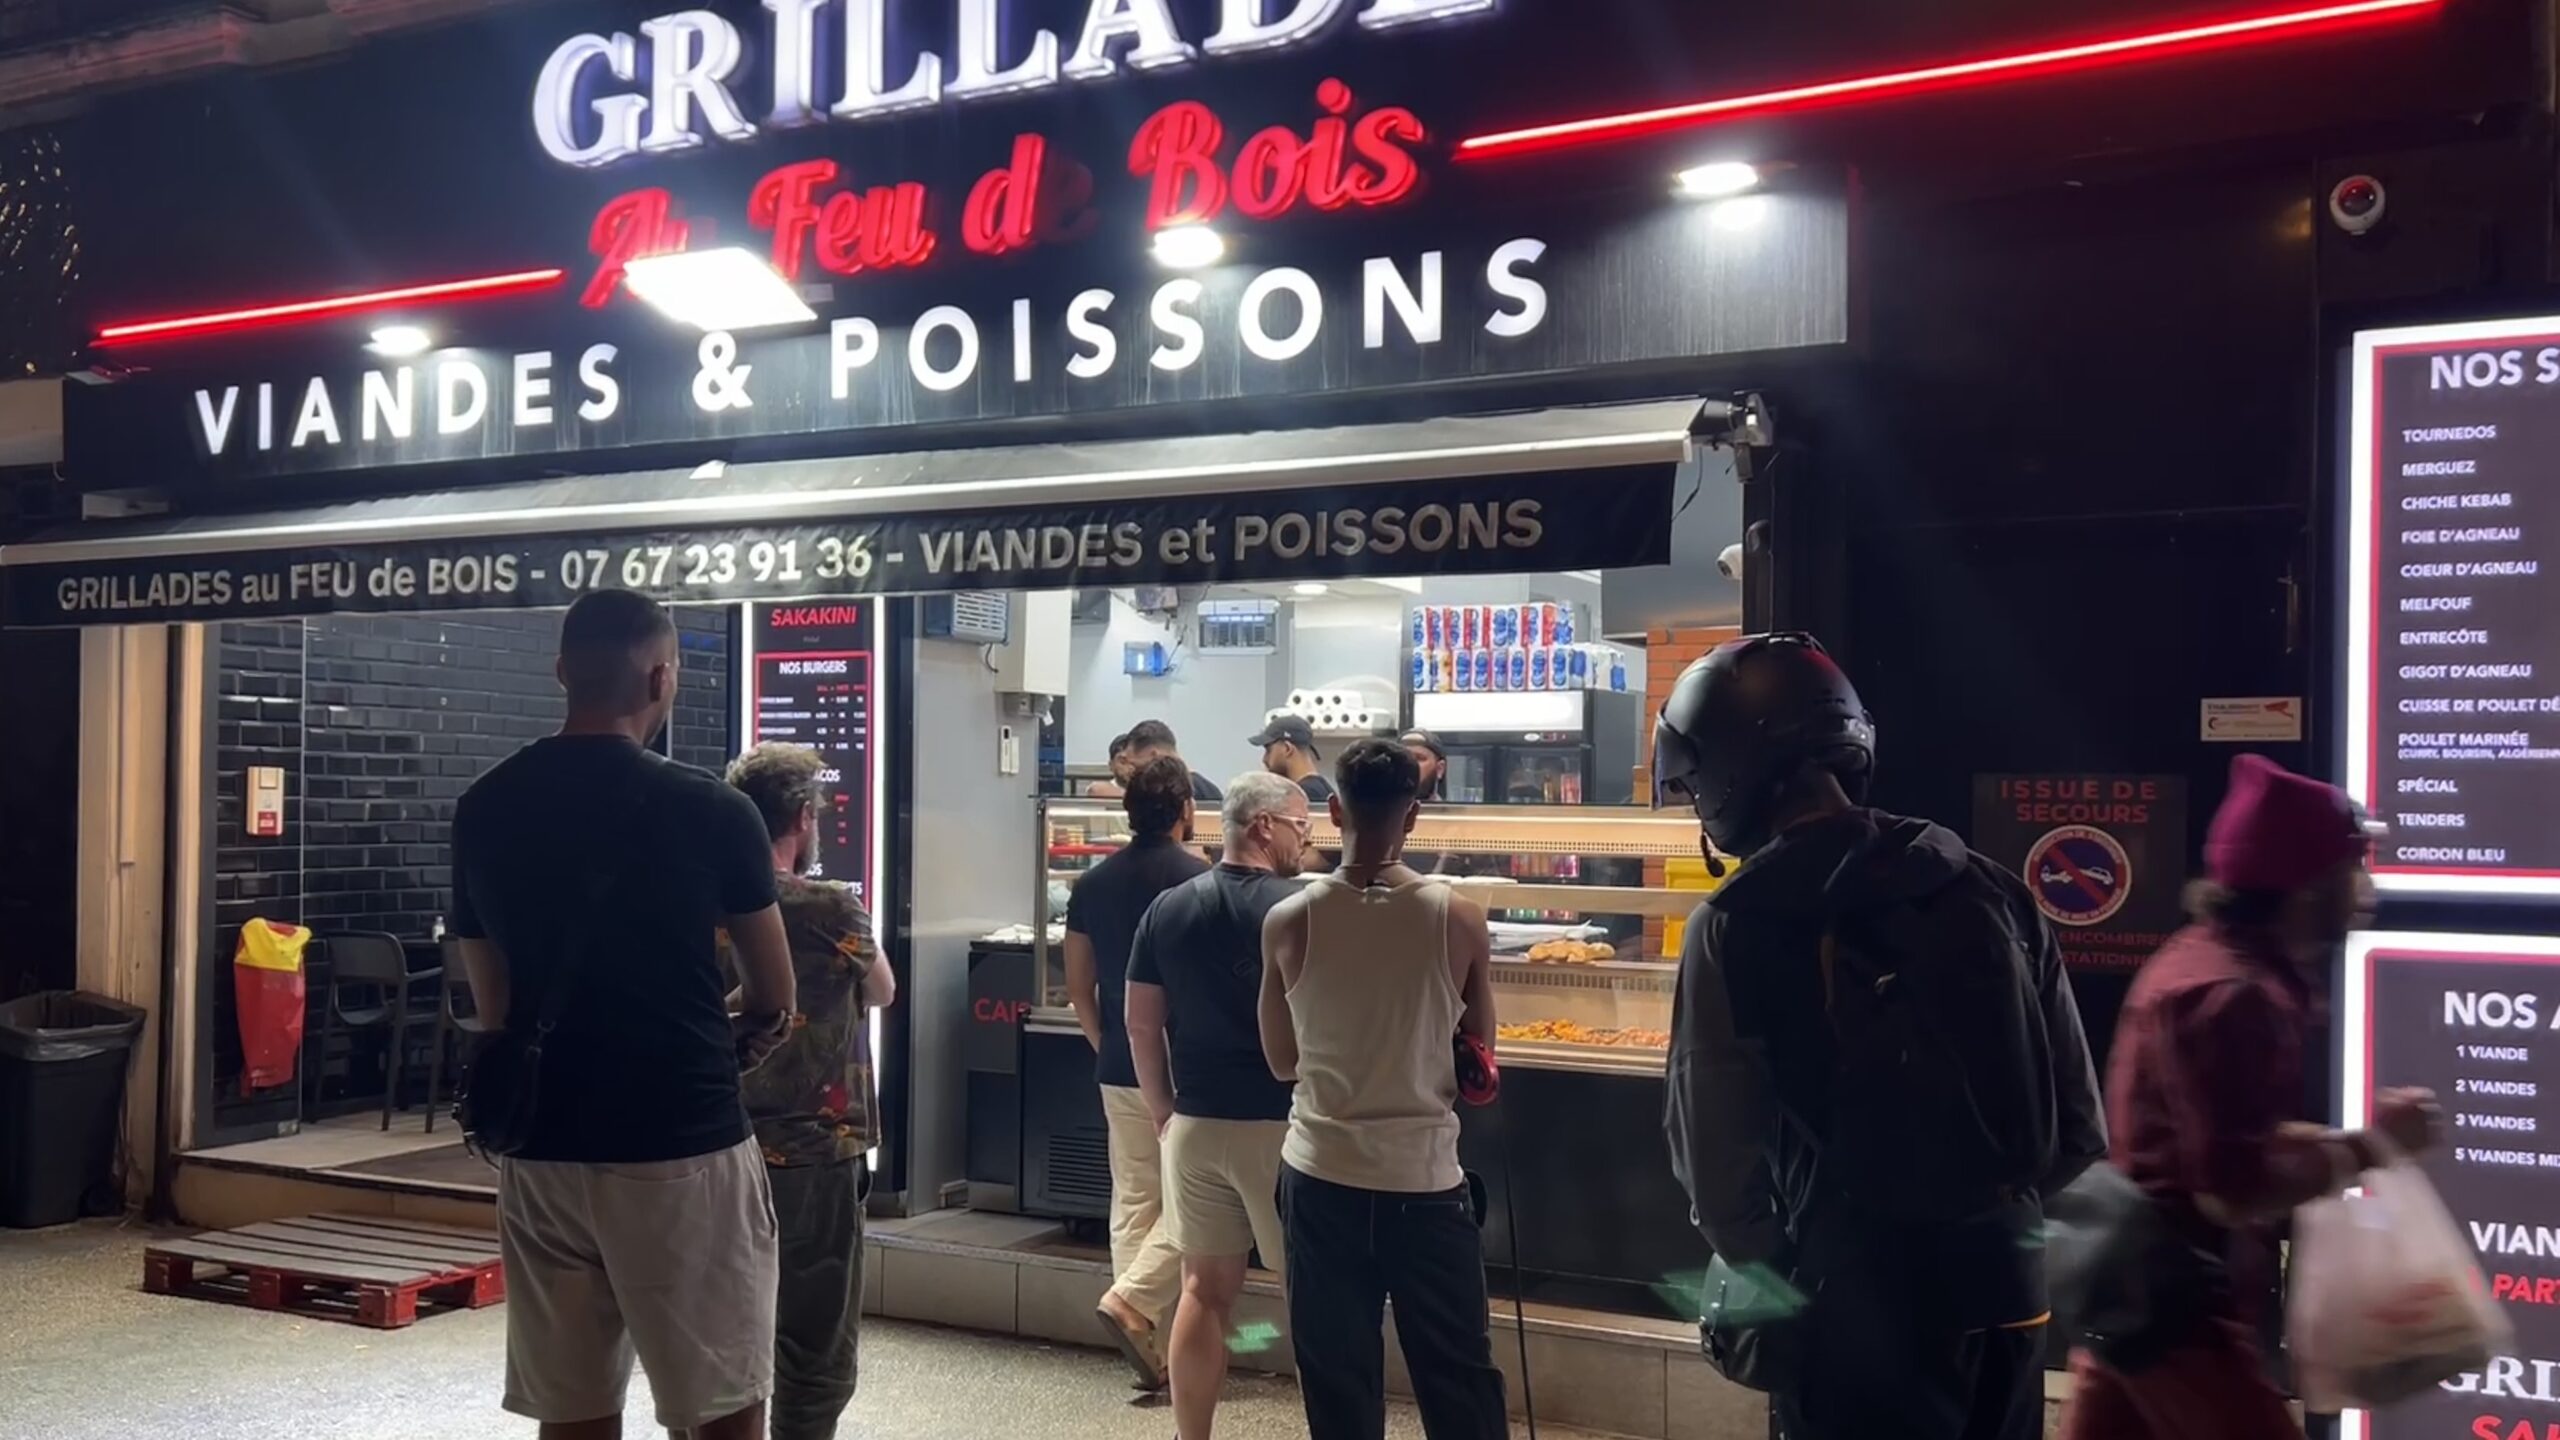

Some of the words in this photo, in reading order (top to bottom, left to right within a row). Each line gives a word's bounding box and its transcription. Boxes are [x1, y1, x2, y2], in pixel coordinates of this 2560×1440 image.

[533, 0, 1500, 167] GRILLA
[748, 158, 936, 280] Feu
[1127, 77, 1424, 232] Bois
[195, 343, 619, 455] VIANDES
[692, 330, 753, 413] &
[831, 237, 1548, 399] POISSONS
[2431, 351, 2523, 390] NOS
[2402, 425, 2496, 443] TOURNEDOS
[2402, 460, 2476, 476] MERGUEZ
[2401, 496, 2457, 510] CHICHE
[2461, 493, 2511, 507] KEBAB
[2402, 530, 2435, 543] FOIE
[2439, 527, 2520, 541] D'AGNEAU
[58, 570, 231, 611] GRILLADES
[241, 572, 279, 602] au
[290, 561, 356, 600] FEU
[368, 557, 415, 598] de
[428, 554, 517, 595] BOIS
[561, 550, 609, 590] 07
[622, 546, 672, 586] 67
[685, 544, 736, 584] 23
[748, 541, 802, 583] 91
[816, 535, 872, 579] 36
[919, 521, 1142, 574] VIANDES
[1159, 518, 1216, 564] et
[1235, 499, 1543, 561] POISSONS
[2400, 564, 2452, 577] COEUR
[2456, 561, 2537, 576] D'AGNEAU
[2400, 597, 2471, 611] MELFOUF
[771, 606, 857, 626] SAKAKINI
[2400, 630, 2487, 644] ENTRECÔTE
[779, 661, 801, 674] NOS
[803, 661, 847, 674] BURGERS
[2399, 665, 2446, 678] GIGOT
[2450, 664, 2531, 678] D'AGNEAU
[2399, 700, 2449, 712] CUISSE
[2453, 700, 2474, 712] DE
[2478, 699, 2536, 712] POULET
[2399, 733, 2453, 746] POULET
[2459, 730, 2528, 746] MARINÉE
[811, 769, 840, 782] ACOS
[2001, 780, 2099, 799] ISSUE
[2113, 781, 2156, 799] DE
[2398, 777, 2457, 792] SPÉCIAL
[2016, 803, 2149, 823] SECOURS
[2397, 813, 2464, 827] TENDERS
[2397, 847, 2462, 860] CORDON
[2467, 848, 2504, 861] BLEU
[2443, 991, 2537, 1028] NOS
[2456, 1045, 2464, 1058] 1
[2469, 1045, 2528, 1061] VIANDE
[2455, 1079, 2465, 1092] 2
[2468, 1079, 2536, 1096] VIANDES
[2455, 1114, 2465, 1127] 3
[2468, 1114, 2536, 1131] VIANDES
[2455, 1148, 2464, 1160] 5
[2468, 1148, 2535, 1165] VIANDES
[2469, 1220, 2560, 1257] VIAN
